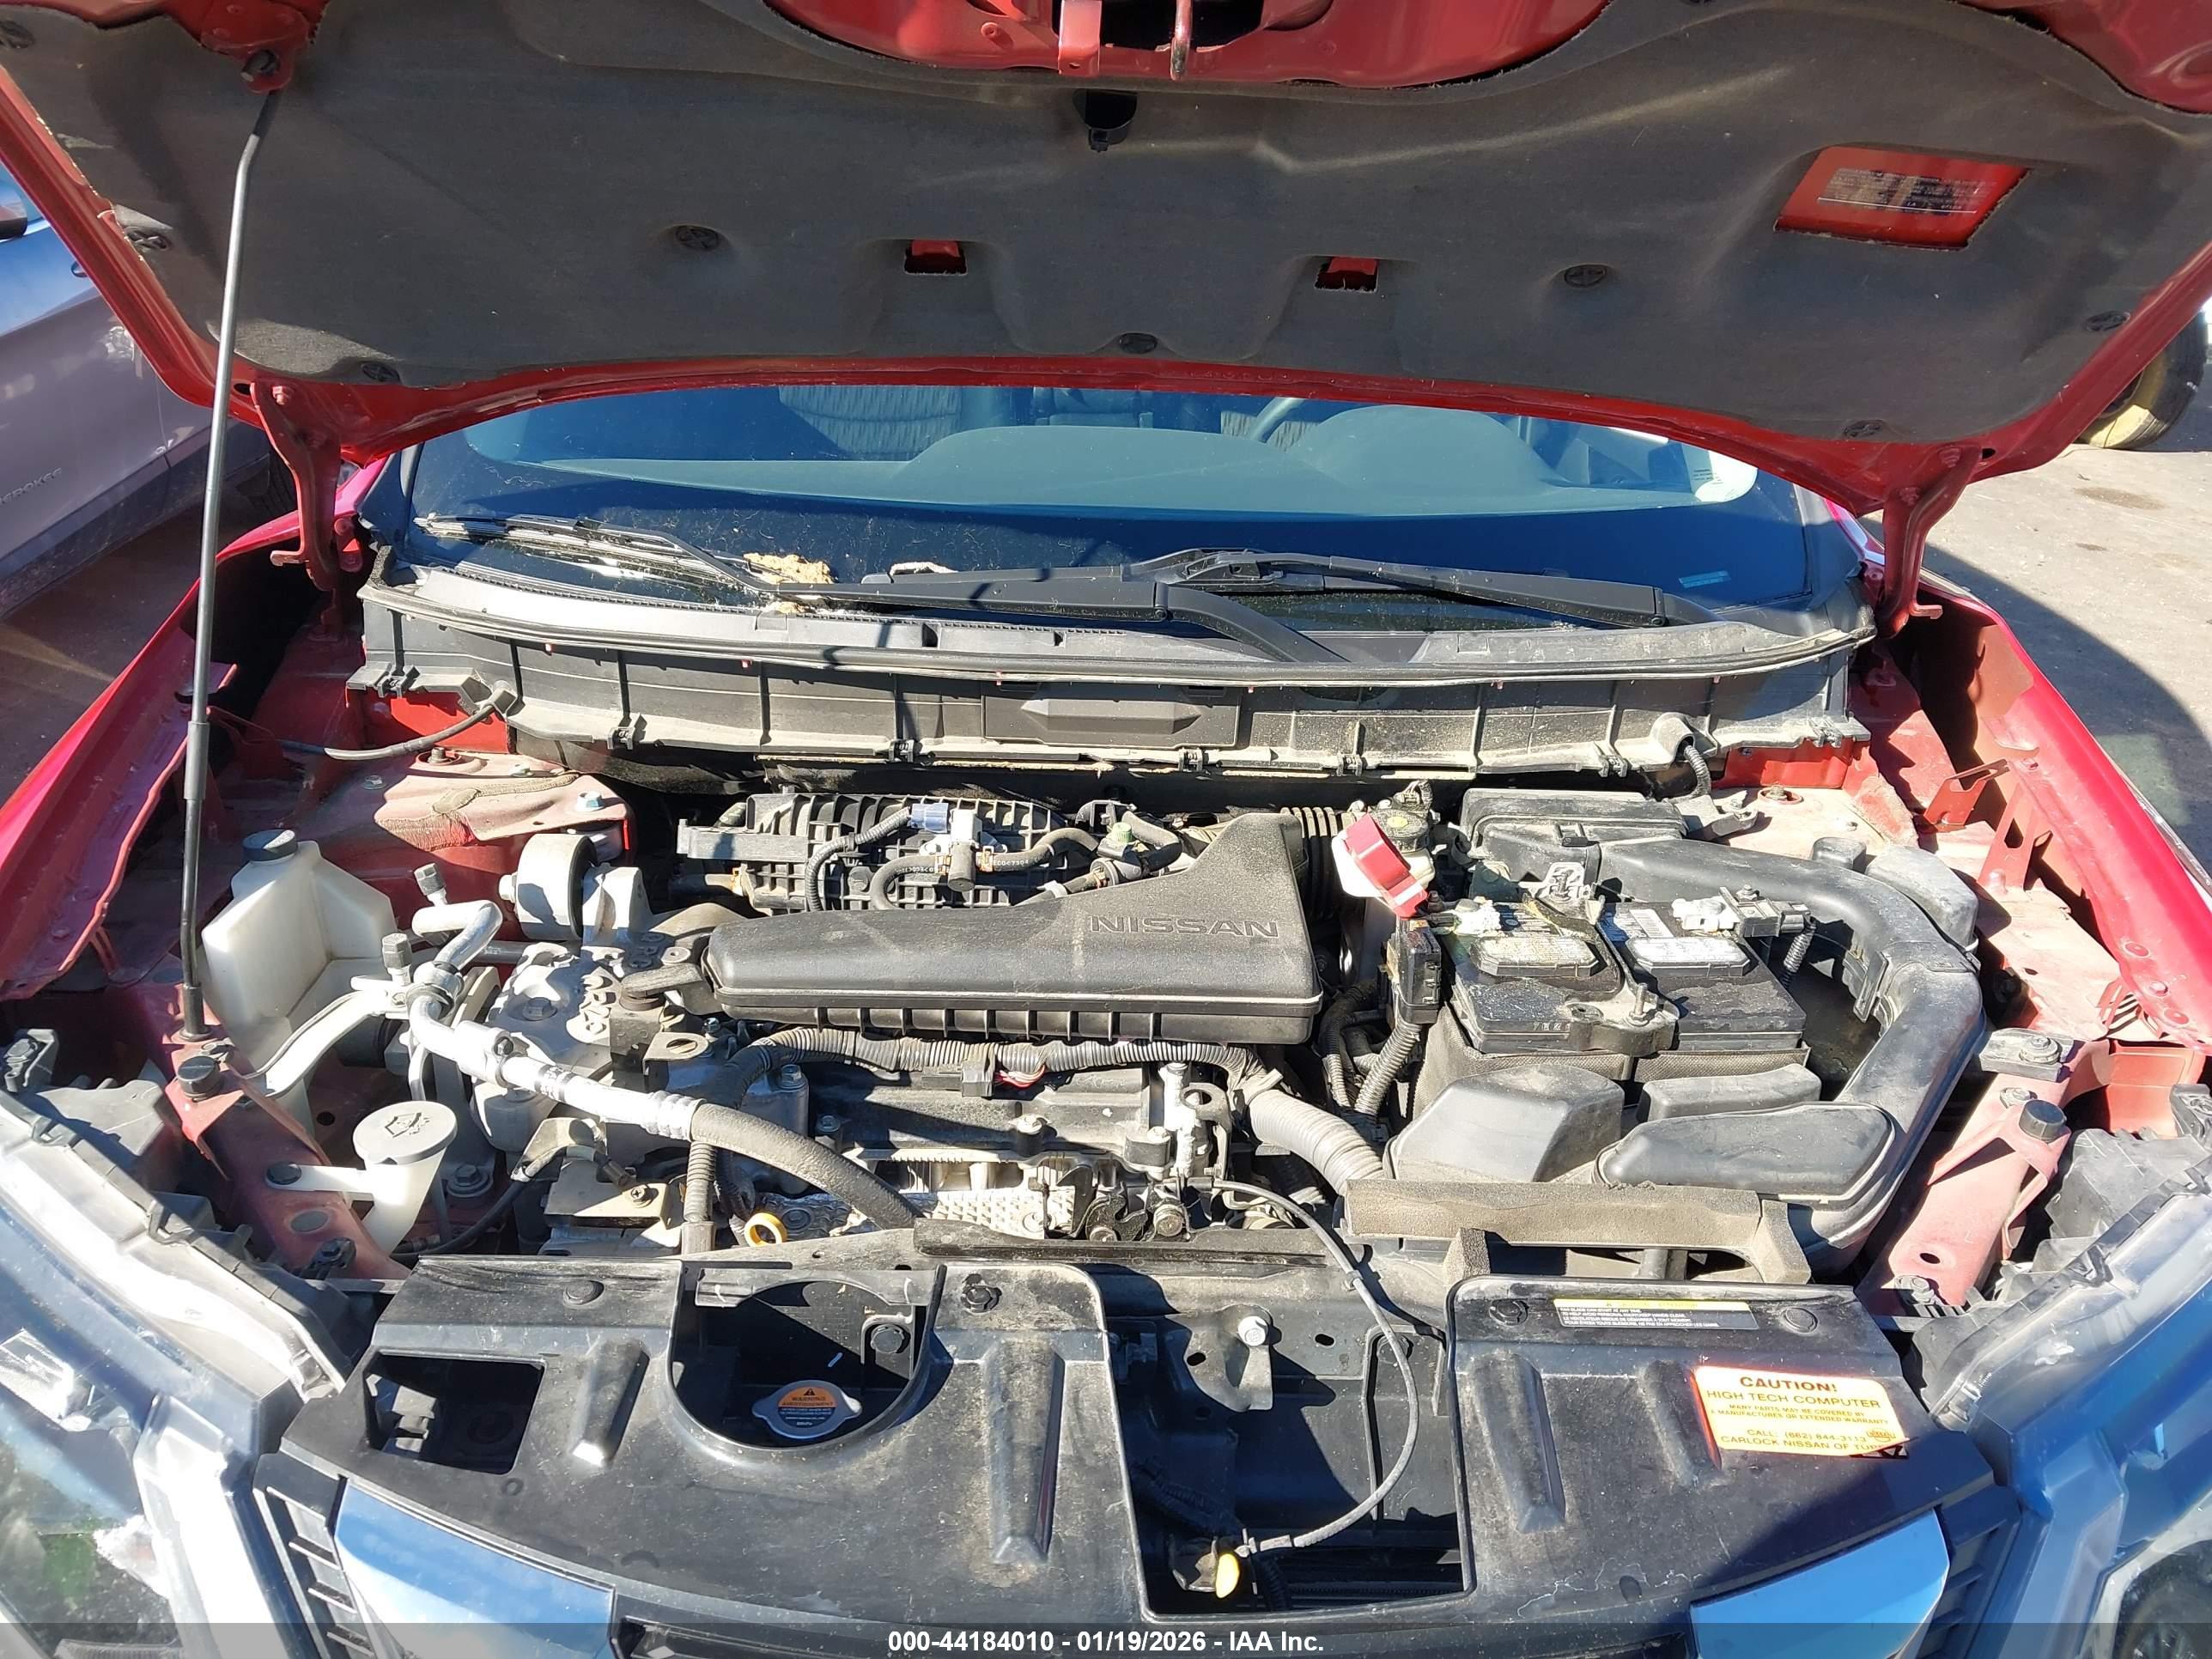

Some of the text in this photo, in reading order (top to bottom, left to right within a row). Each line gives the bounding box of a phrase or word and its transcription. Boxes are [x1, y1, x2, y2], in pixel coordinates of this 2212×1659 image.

[1088, 915, 1279, 938] NISSAN
[1740, 1376, 1838, 1392] CAUTION!
[1707, 1390, 1881, 1408] HIGH TECH COMPUTER
[1721, 1436, 1779, 1446] CARLOCK
[1784, 1440, 1830, 1449] NISSAN
